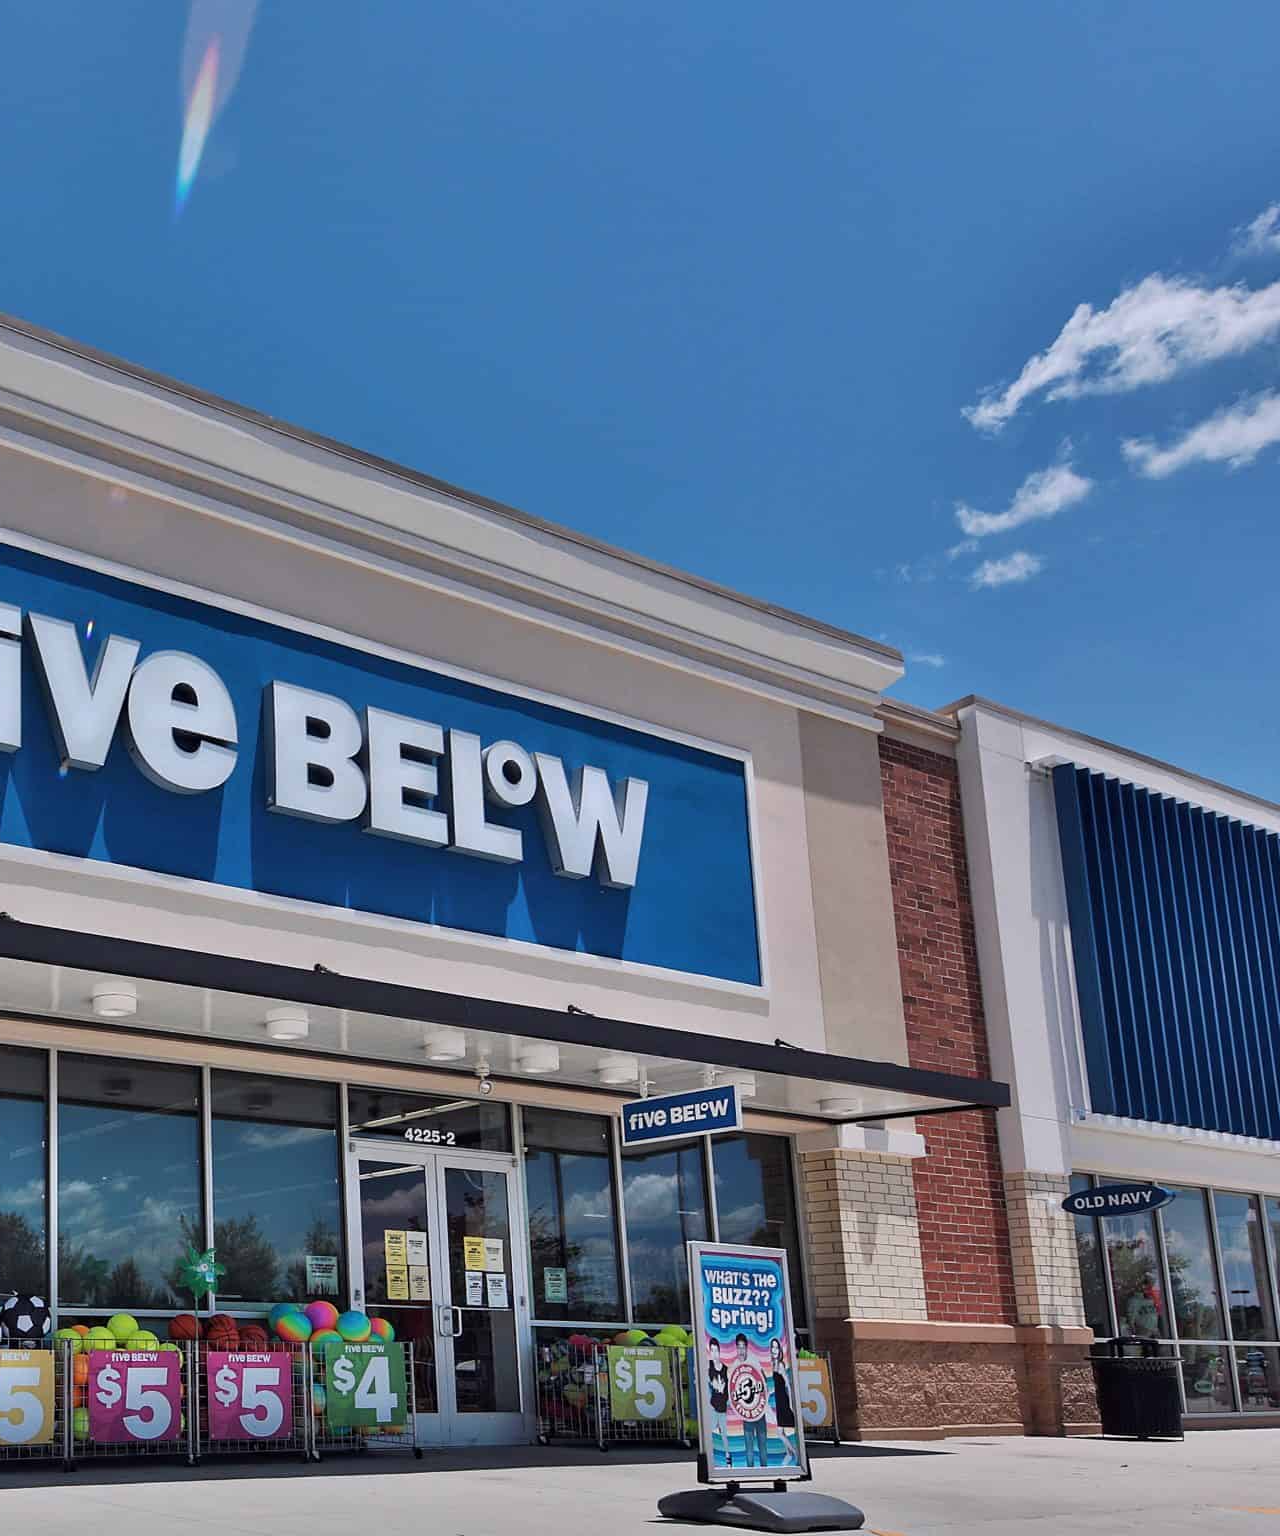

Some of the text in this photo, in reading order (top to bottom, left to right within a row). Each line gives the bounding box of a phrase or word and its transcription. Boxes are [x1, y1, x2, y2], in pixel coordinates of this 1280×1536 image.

[404, 1127, 456, 1146] 4225-2
[629, 1109, 667, 1131] five
[1074, 1190, 1153, 1210] OLD NAVY
[711, 1307, 773, 1333] spring!
[95, 1364, 173, 1440] $5
[213, 1364, 284, 1438] $5
[331, 1355, 398, 1423] $4
[615, 1356, 666, 1419] $5
